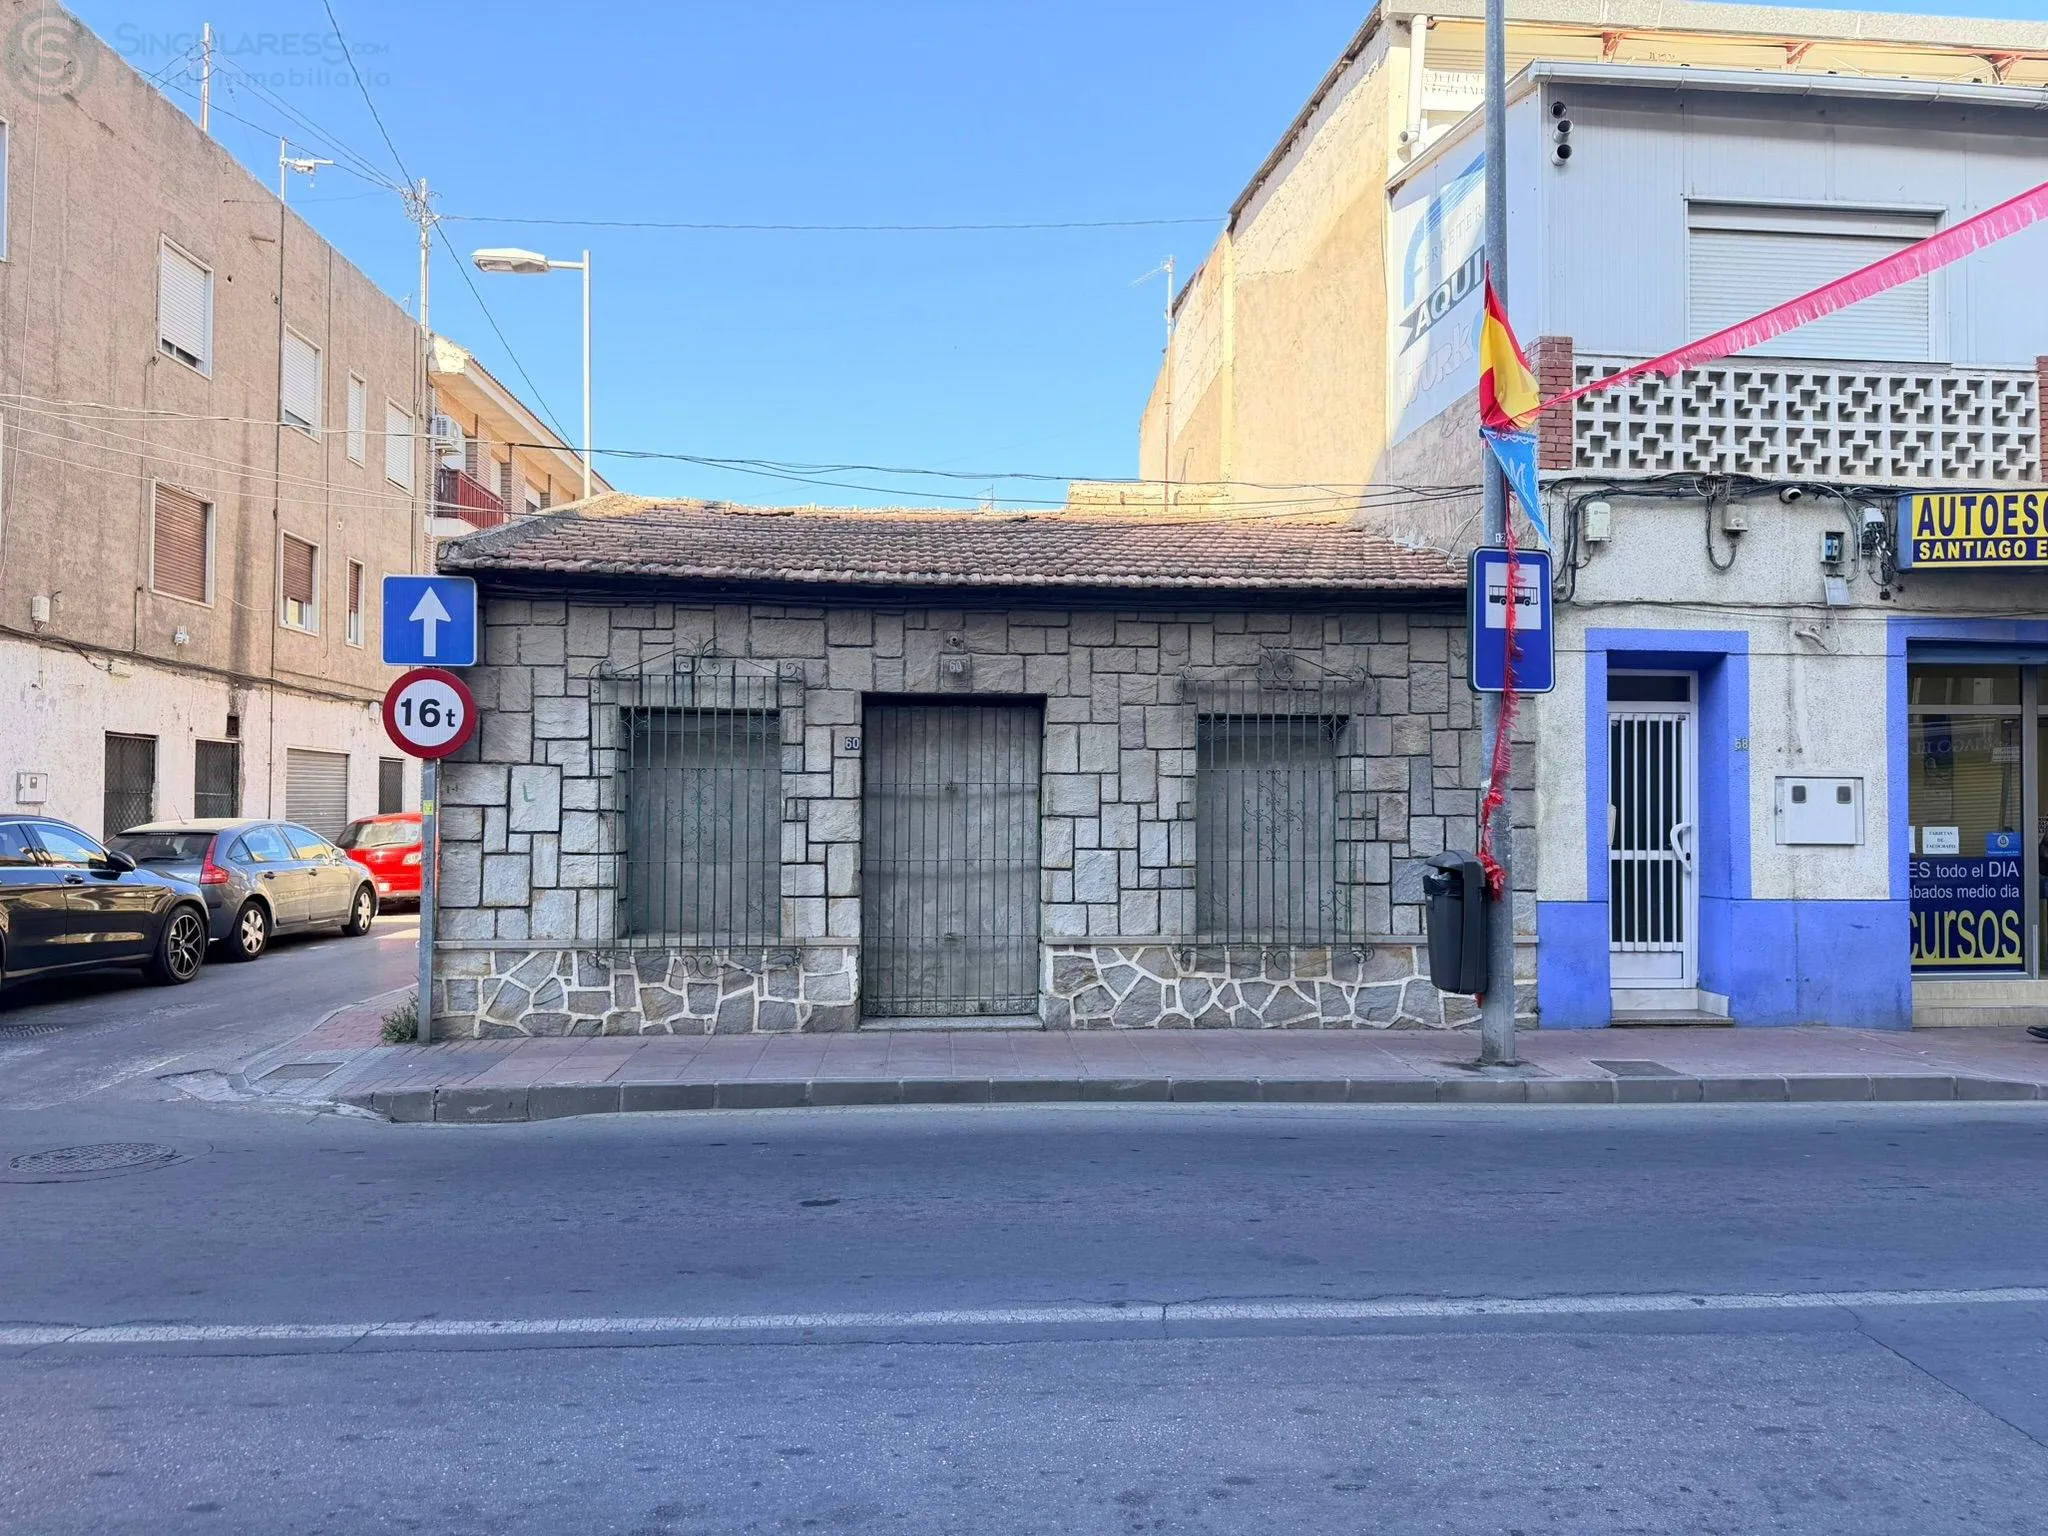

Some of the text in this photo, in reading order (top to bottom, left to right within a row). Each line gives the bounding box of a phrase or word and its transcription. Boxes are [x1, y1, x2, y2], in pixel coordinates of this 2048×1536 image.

[1917, 494, 2048, 537] AUTOES
[1919, 540, 2027, 560] SANTIAGO
[845, 737, 859, 749] 60
[1936, 864, 1967, 878] todo
[1972, 864, 1984, 877] el
[1989, 861, 2019, 878] DIA
[1957, 885, 1997, 898] medio
[2000, 885, 2019, 898] dia
